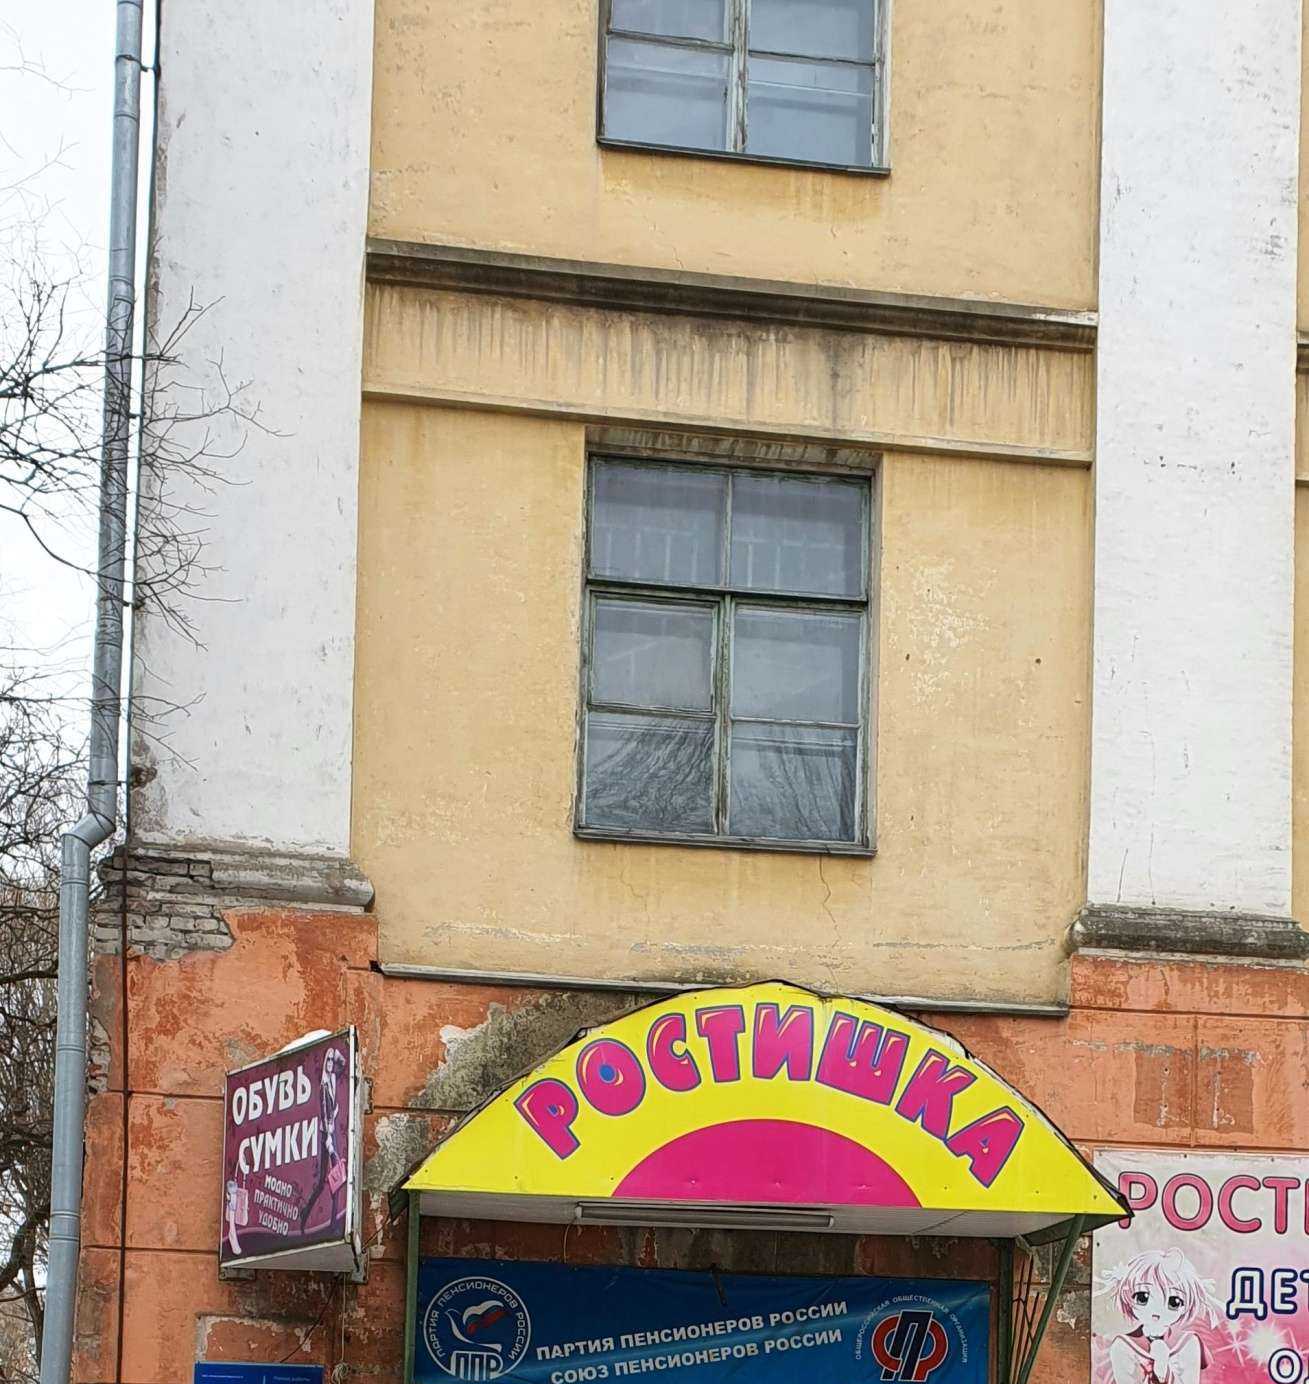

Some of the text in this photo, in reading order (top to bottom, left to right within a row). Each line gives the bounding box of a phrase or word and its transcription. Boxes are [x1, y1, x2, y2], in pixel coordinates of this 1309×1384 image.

[232, 1066, 312, 1126] ОБУВЬ
[513, 1002, 1025, 1189] РОСТИШКА
[238, 1116, 319, 1175] СУМКИ
[253, 1188, 299, 1221] ПРАКТИЧНО
[265, 1174, 293, 1198] МОДНО
[1117, 1171, 1309, 1235] РОСТ
[258, 1209, 288, 1236] УДОБНО
[426, 1280, 528, 1361] ПАРТИЯ ПЕНСИОНЕРОВ РОССИИ
[536, 1300, 848, 1361] ПАРТИЯ ПЕНСИОНЕРОВ РОССИИ
[450, 1351, 504, 1382] ППР
[614, 1340, 759, 1377] ПЕНСИОНЕРОВ
[764, 1328, 843, 1355] РОССИИ
